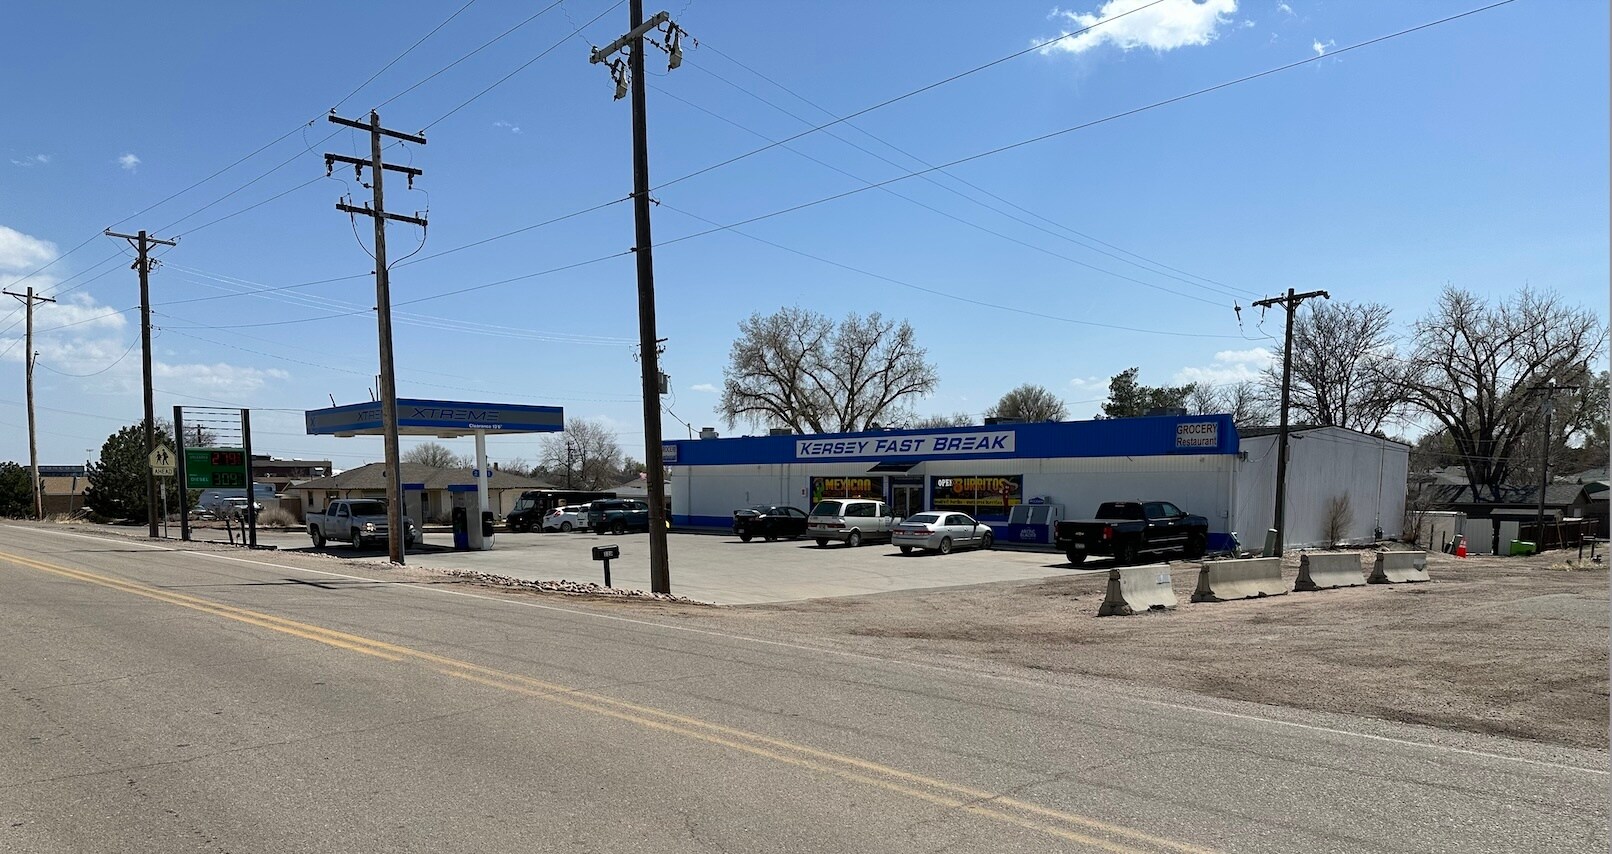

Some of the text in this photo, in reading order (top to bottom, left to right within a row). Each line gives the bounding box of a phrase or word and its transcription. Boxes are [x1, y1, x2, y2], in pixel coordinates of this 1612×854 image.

[357, 409, 381, 422] XTRE
[411, 407, 499, 421] XTREME
[1177, 423, 1218, 435] GROCERY
[800, 435, 1008, 455] KERSEY FAST BREAK
[1177, 437, 1217, 446] Restaurant
[154, 467, 173, 475] AHEAD
[825, 478, 872, 491] MEXICAN
[953, 478, 1005, 493] BURRITOS
